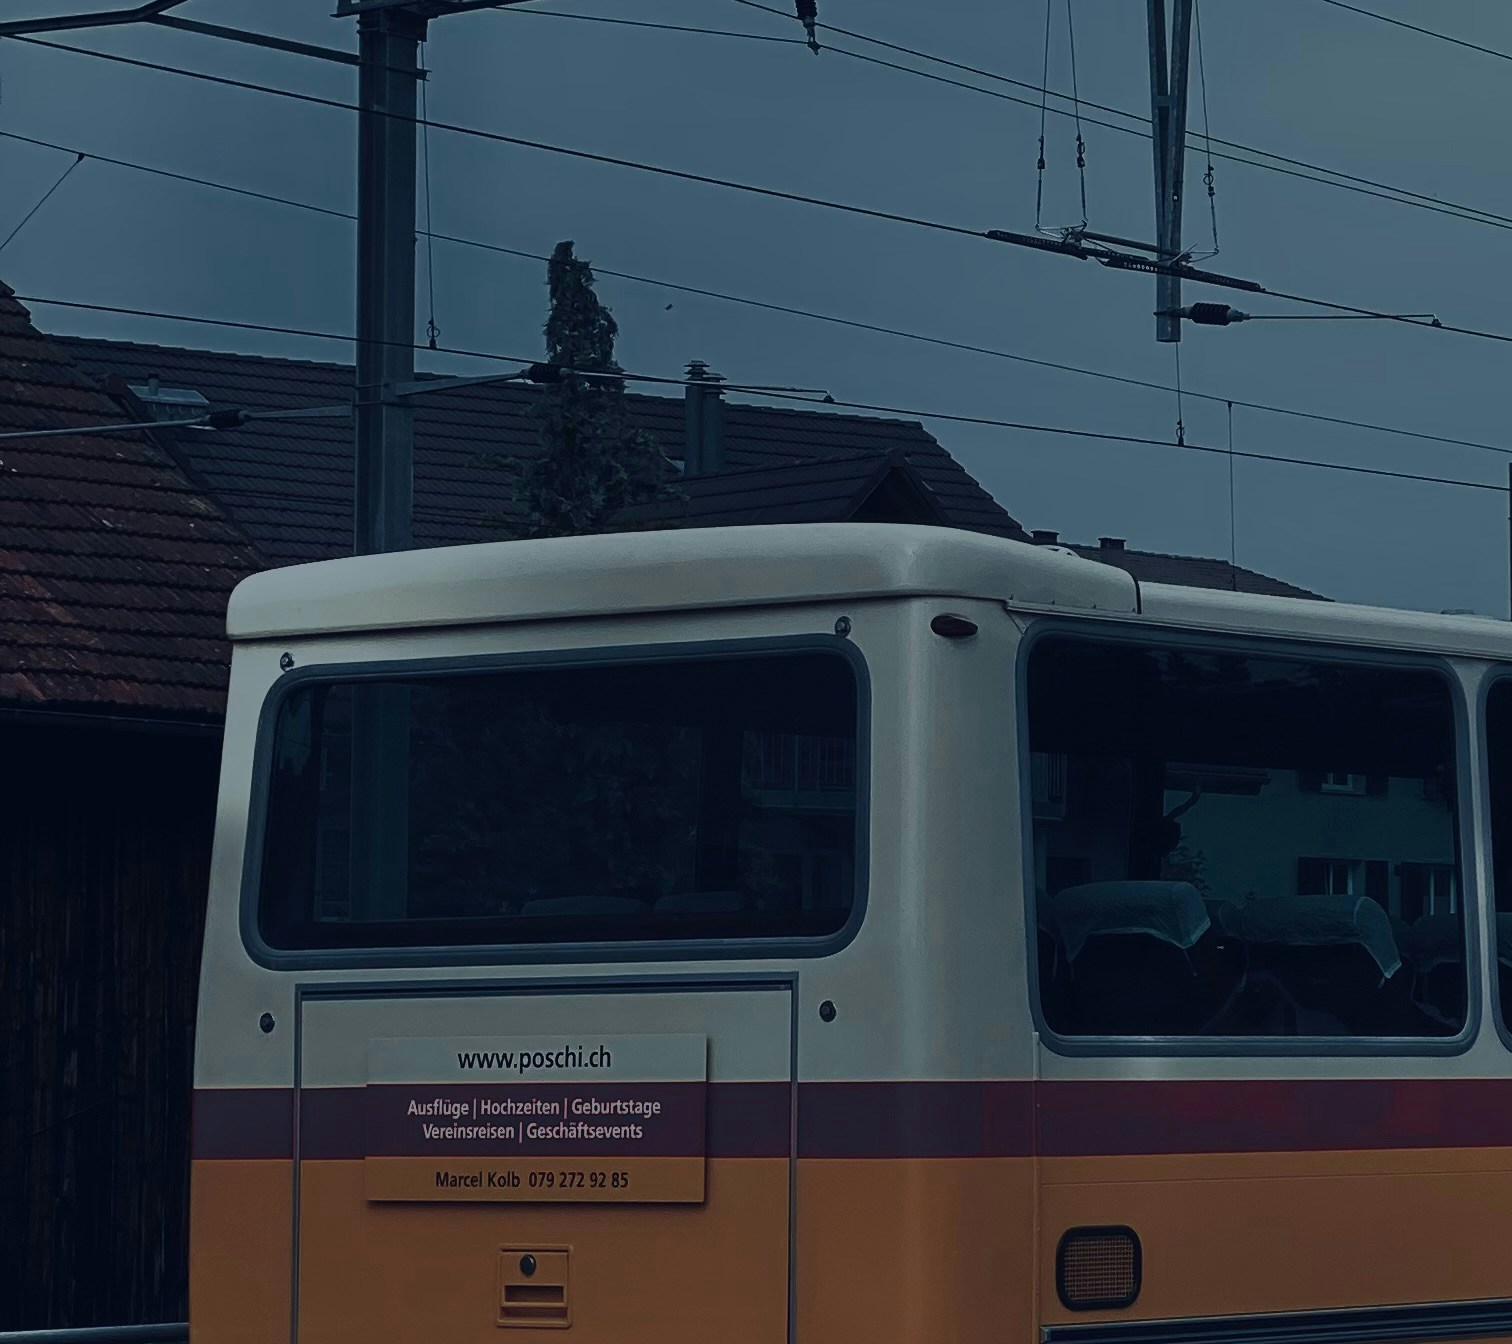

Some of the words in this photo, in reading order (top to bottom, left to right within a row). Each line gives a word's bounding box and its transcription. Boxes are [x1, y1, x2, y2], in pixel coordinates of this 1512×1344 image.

[457, 1045, 612, 1074] www.poschi.ch
[407, 1098, 470, 1119] Ausflüge
[480, 1097, 560, 1115] Hochzeiten
[571, 1097, 661, 1118] Geburtstage
[422, 1122, 515, 1139] Vereinsreisen
[526, 1121, 643, 1139] Geschäftsevents
[435, 1170, 483, 1188] Marcel
[487, 1171, 521, 1188] Kolb
[528, 1171, 555, 1188] 079
[558, 1171, 585, 1188] 272
[589, 1171, 607, 1188] 92
[611, 1171, 629, 1188] 85
